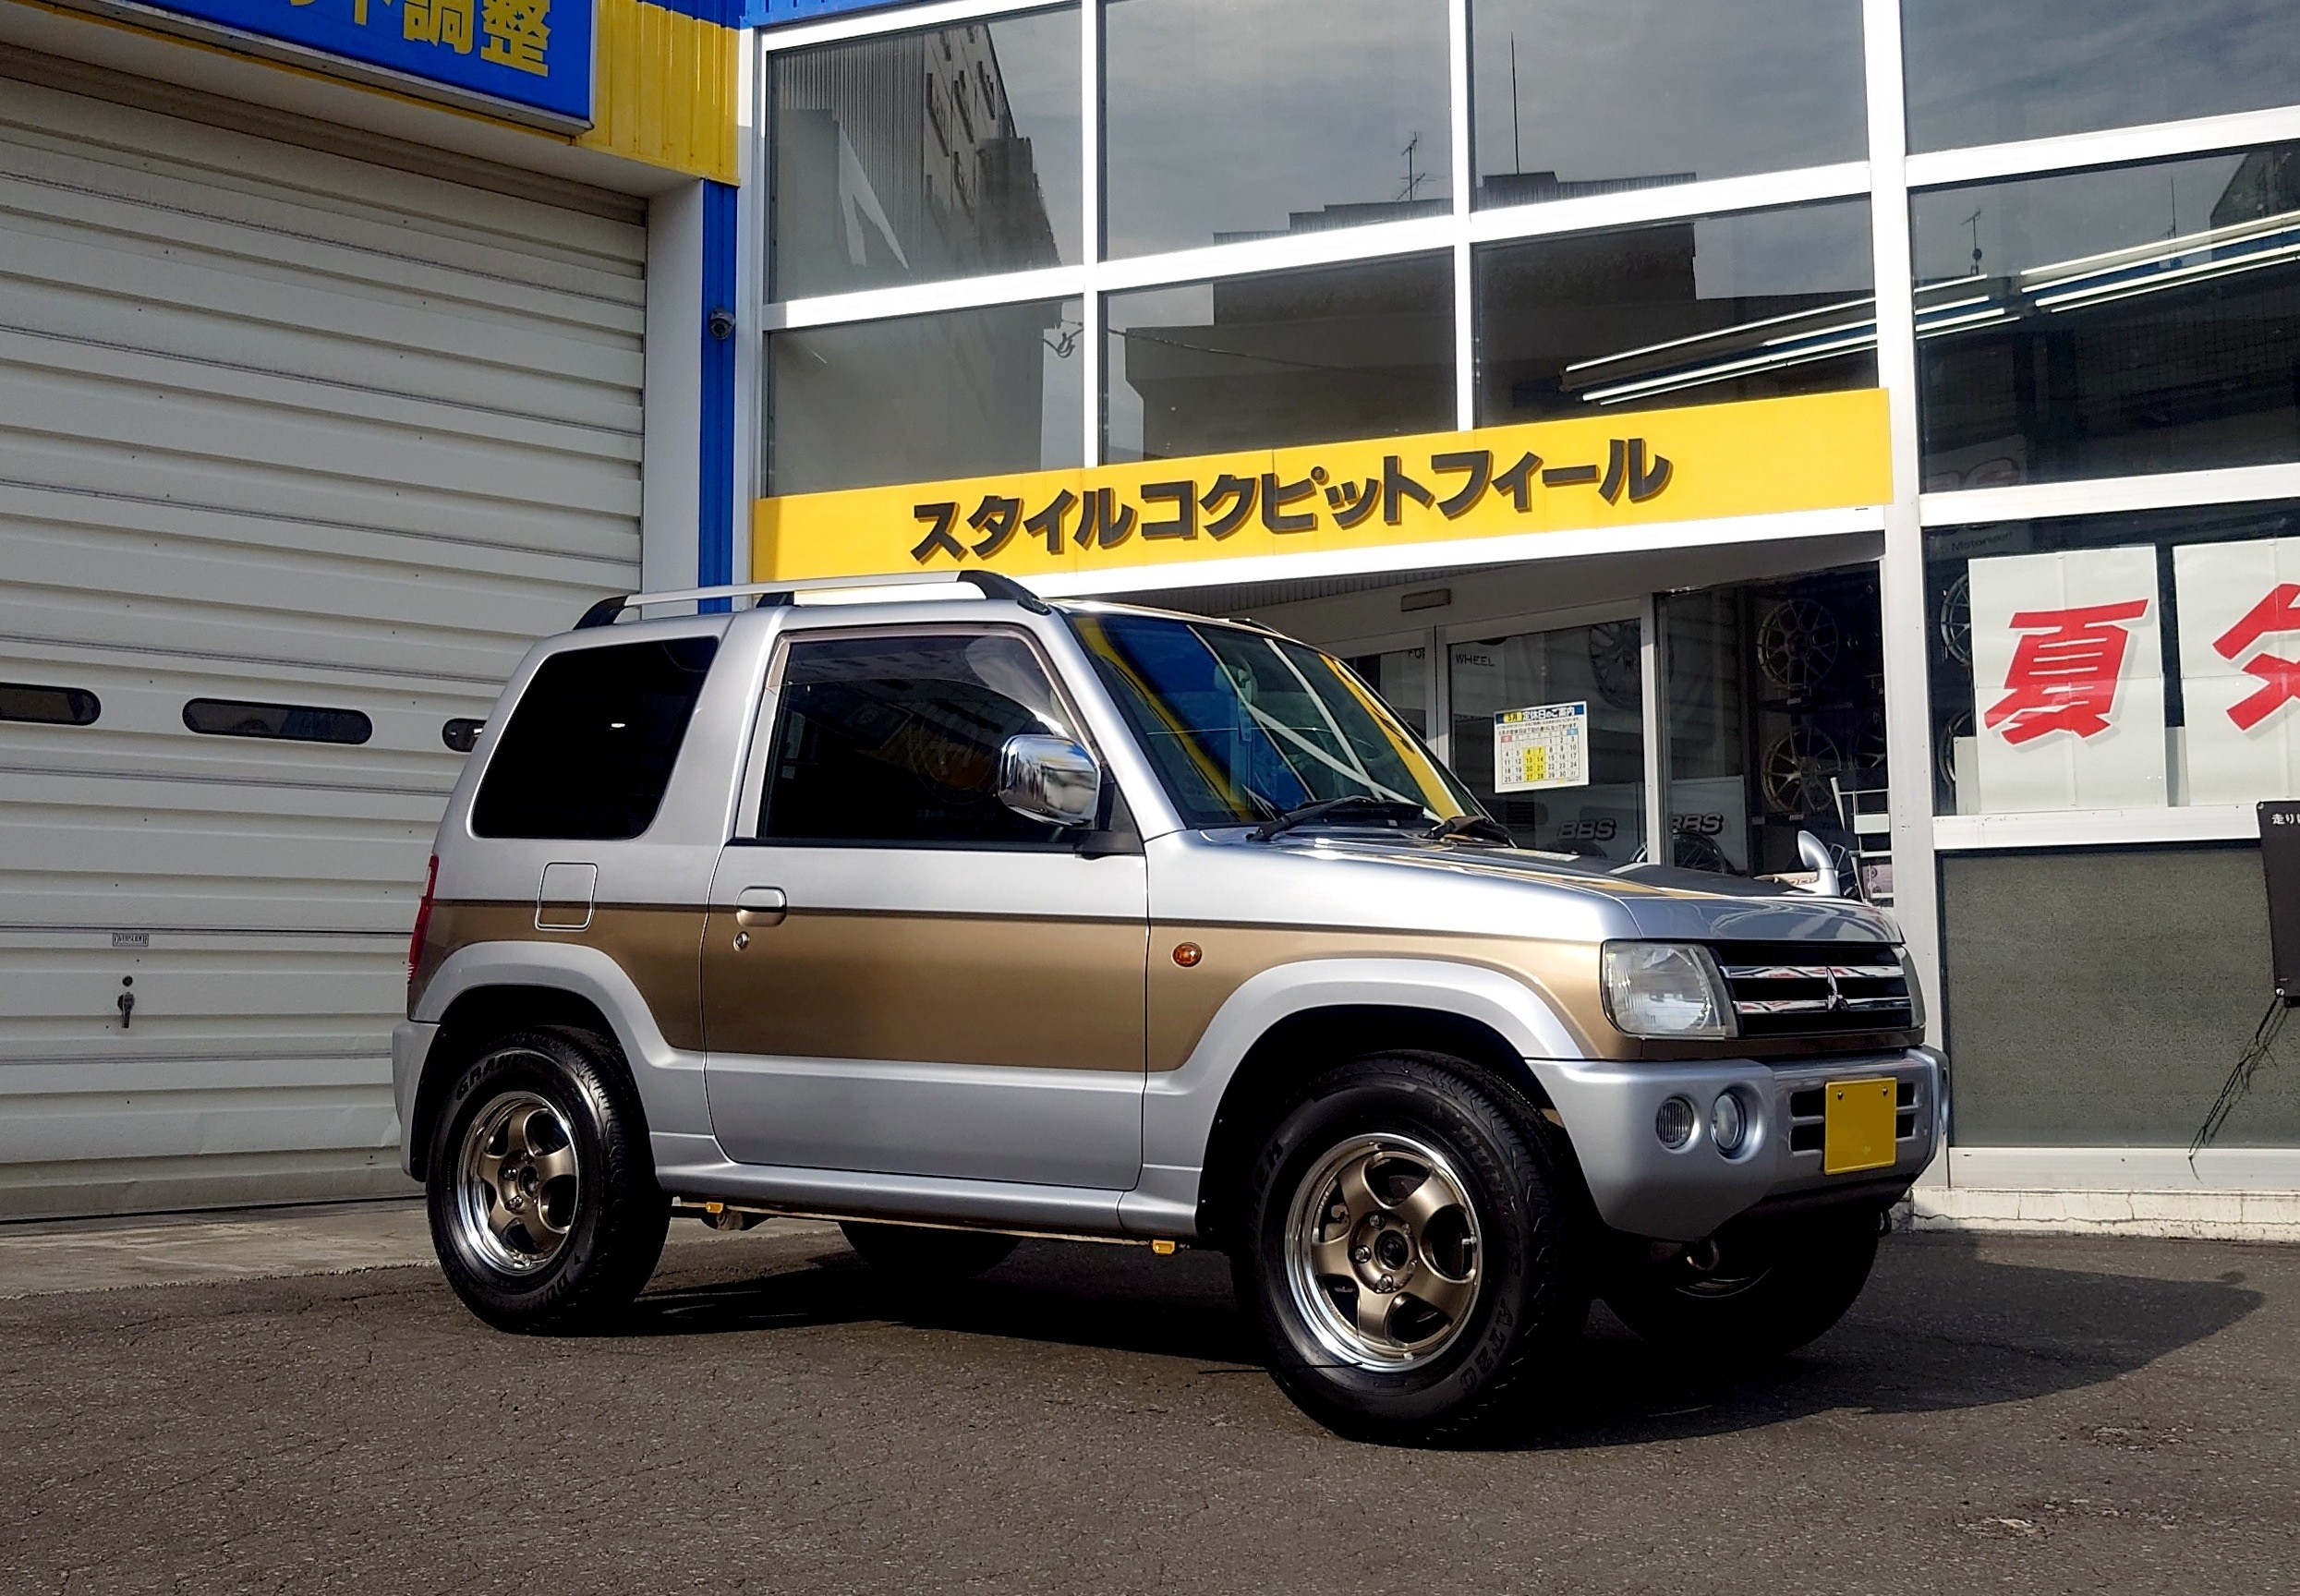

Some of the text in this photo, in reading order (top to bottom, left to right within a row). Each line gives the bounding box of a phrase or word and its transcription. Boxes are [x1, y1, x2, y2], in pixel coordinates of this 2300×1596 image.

[910, 438, 1673, 565] スタイルコクピットフィール
[1456, 654, 1495, 667] WHEEL
[1558, 817, 1616, 840] BBS
